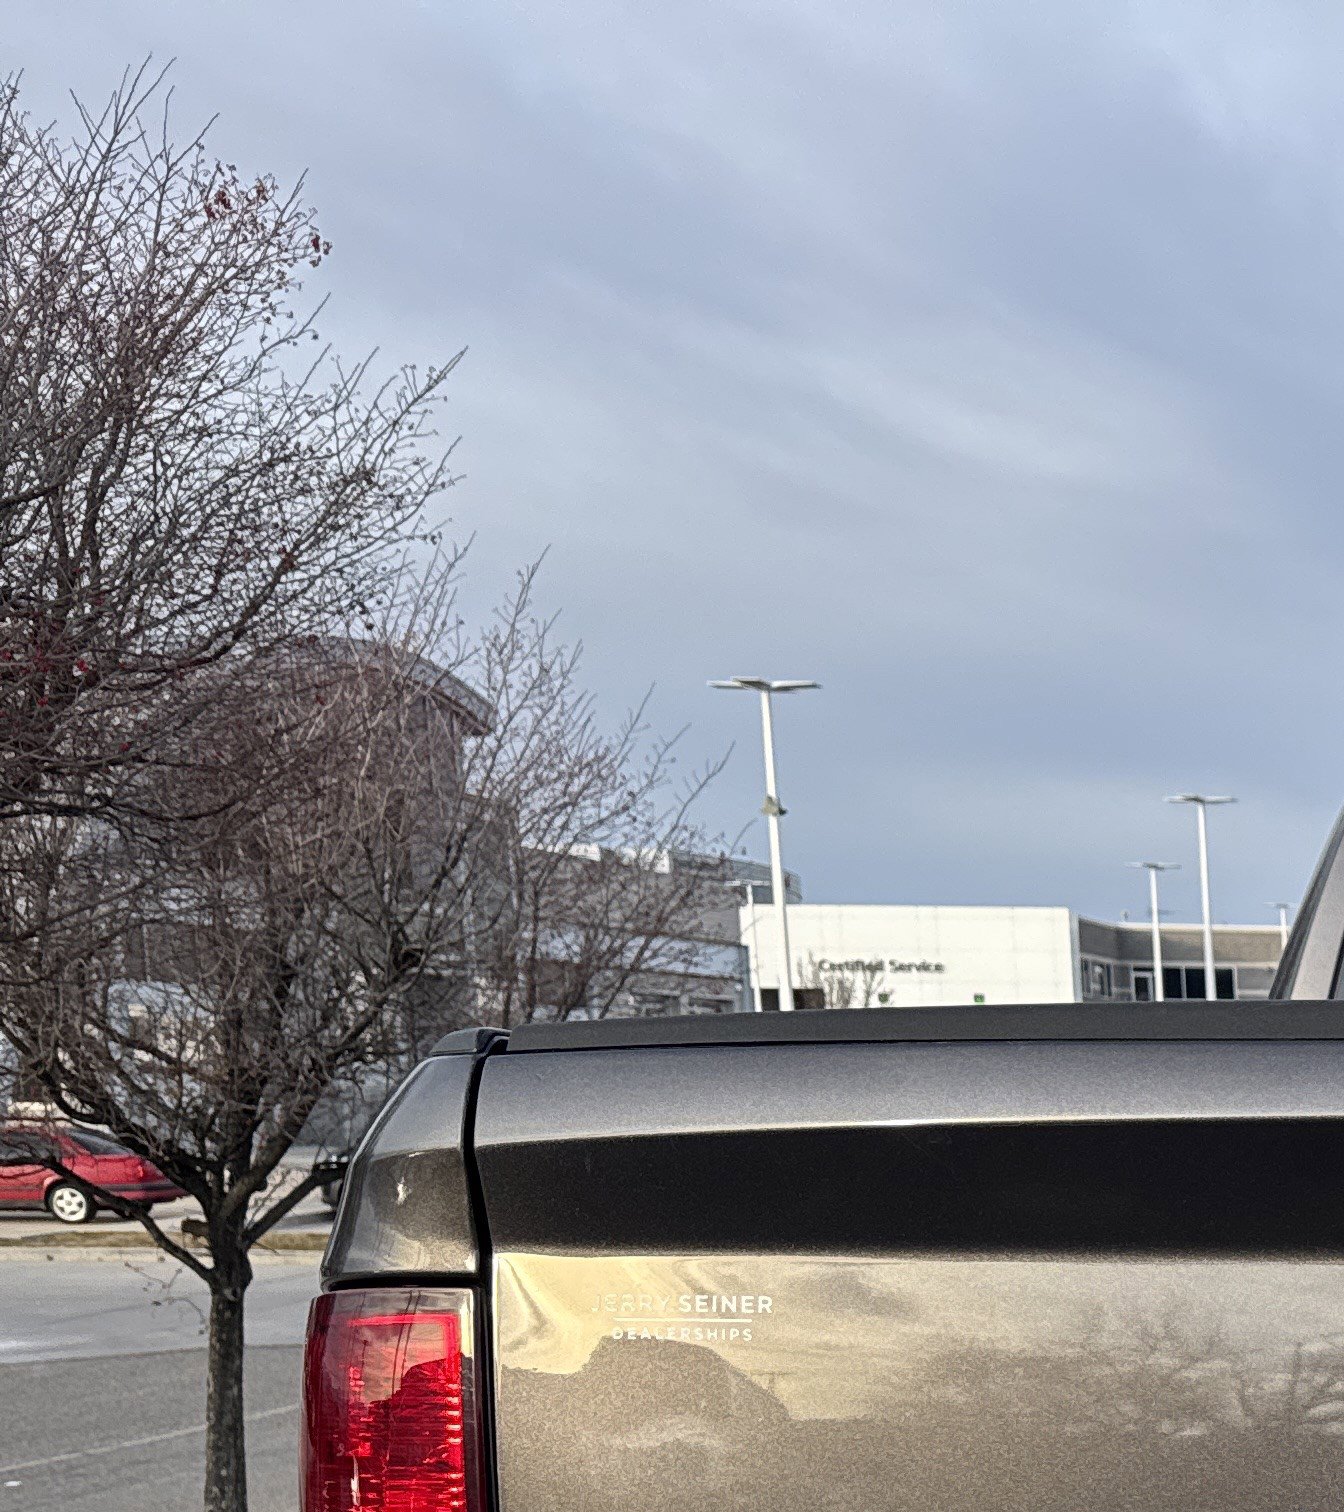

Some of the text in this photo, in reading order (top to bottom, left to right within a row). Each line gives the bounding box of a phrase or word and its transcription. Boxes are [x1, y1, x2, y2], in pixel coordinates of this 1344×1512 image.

[818, 958, 946, 973] Certified Service
[590, 1293, 774, 1314] JERRY SEINER
[612, 1326, 753, 1342] DEALERSHIPS
